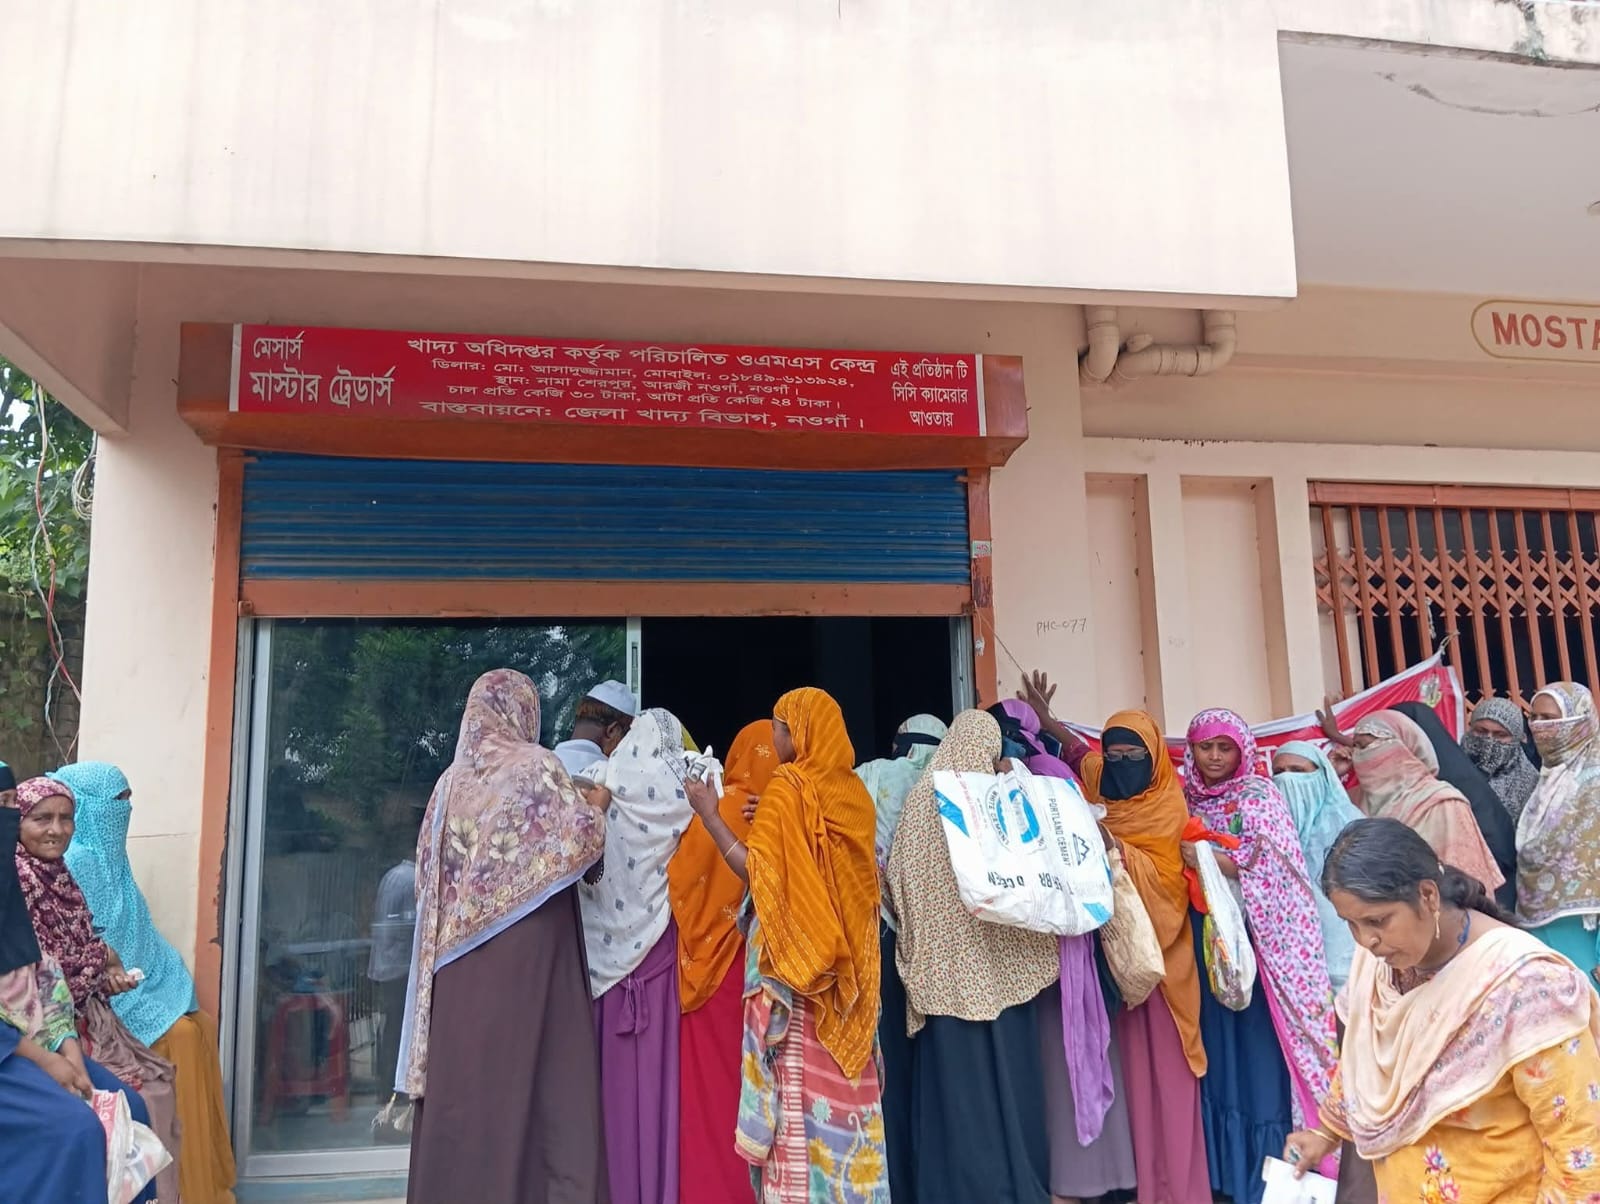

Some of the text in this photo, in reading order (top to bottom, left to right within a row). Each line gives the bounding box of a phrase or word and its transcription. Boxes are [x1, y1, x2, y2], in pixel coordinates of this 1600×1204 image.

[253, 330, 305, 360] মেসার্স
[408, 338, 878, 374] খাদ্য অধিদপ্তর কর্তৃক পরিচালিত ওএমএস কেন্দ্র
[891, 358, 909, 379] এই
[912, 358, 954, 380] প্রতিষ্ঠান
[249, 362, 396, 408] মাস্টার ট্রেডার্স
[536, 377, 570, 387] নামা
[642, 380, 691, 392] আরজী
[892, 381, 968, 404] সিসি ক্যামেরার
[447, 385, 478, 396] চাল
[482, 386, 518, 397] প্রতি
[523, 386, 565, 399] কেজি
[570, 391, 594, 399] ৩০
[647, 392, 682, 403] আটা
[688, 392, 721, 405] প্রতি
[725, 394, 765, 406] কেজি
[771, 397, 791, 407] ২৪
[564, 406, 630, 420] জেলা
[637, 407, 691, 423] খাদ্য
[699, 408, 777, 427] বিভাগ,
[909, 410, 954, 427] আওতায়
[1048, 798, 1065, 836] PORTLAND
[1057, 836, 1072, 867] CEMENT
